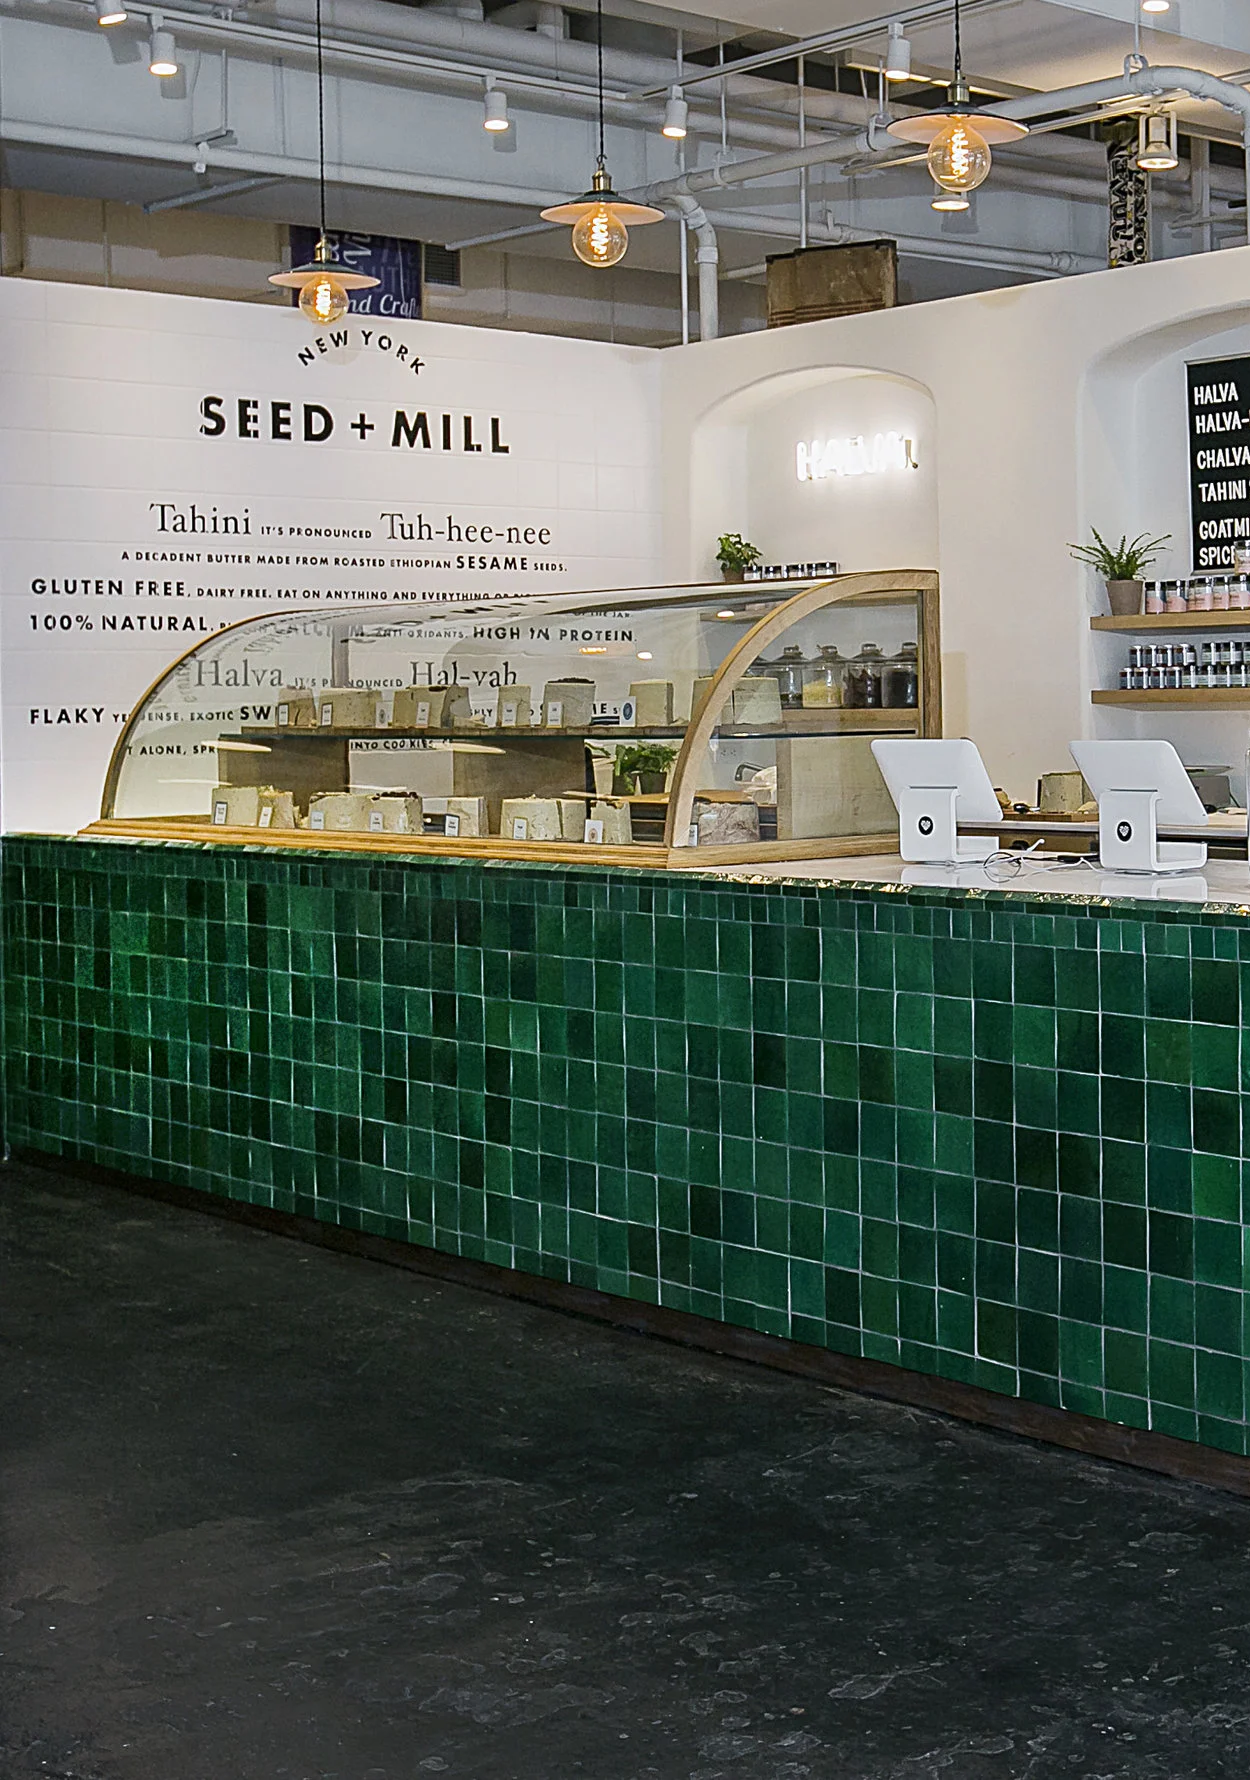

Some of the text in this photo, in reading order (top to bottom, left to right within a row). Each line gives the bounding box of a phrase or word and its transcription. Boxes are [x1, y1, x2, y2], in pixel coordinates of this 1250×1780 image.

[298, 330, 425, 374] NEW YORK
[1194, 381, 1239, 406] HALVA
[199, 396, 335, 442] SEED
[391, 410, 510, 453] MILL
[1198, 479, 1247, 502] TAHINI
[149, 503, 551, 545] Tahini IT'S PRONOUNCED Tuh-hee-nee
[121, 551, 130, 561] A
[136, 552, 201, 563] DECADENT
[207, 554, 251, 564] BUTTER
[256, 555, 291, 565] MADE
[295, 556, 329, 566] FROM
[334, 557, 385, 567] ROASTED
[390, 559, 451, 569] ETHIOPIAN
[456, 555, 528, 571] SESAME
[31, 578, 123, 596] GLUTEN
[135, 581, 191, 598] FREE,
[197, 588, 235, 598] DAIRY
[277, 589, 298, 599] EAT
[302, 589, 321, 599] ON
[325, 590, 388, 600] ANYTHING
[393, 591, 417, 600] AND
[30, 614, 94, 631] 100%
[101, 615, 214, 632] NATURAL.
[473, 626, 520, 640] HIGH
[529, 627, 550, 641] IN
[559, 629, 638, 642] PROTEIN.
[194, 658, 284, 688] Halva
[409, 661, 518, 688] Hal-vah
[30, 708, 105, 724] FLAKY
[190, 711, 234, 721] EXOTIC
[350, 741, 379, 750] INTO
